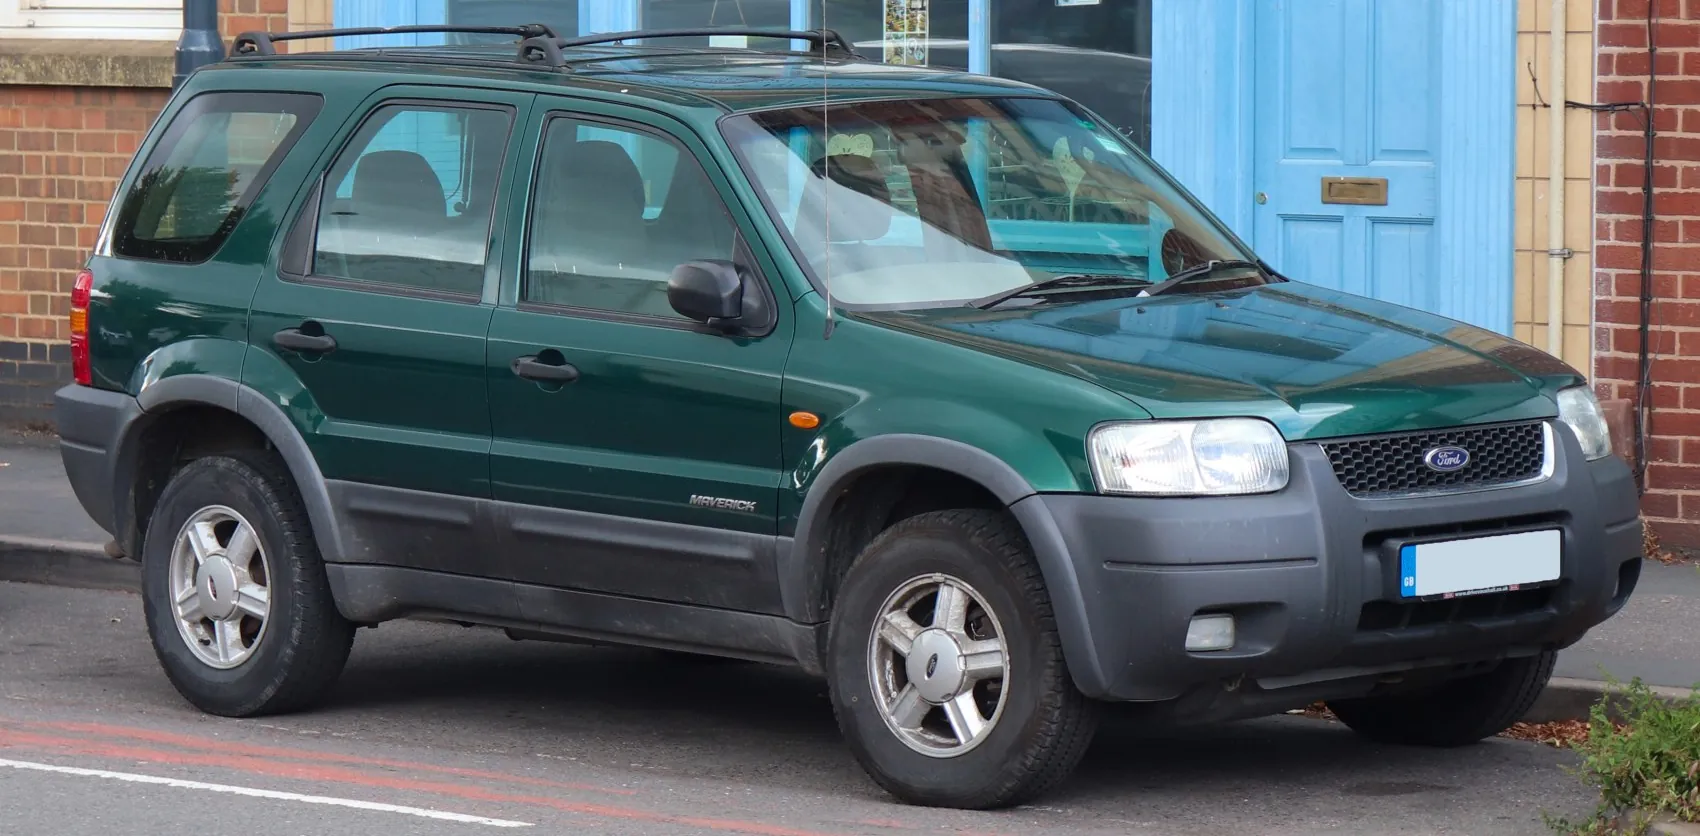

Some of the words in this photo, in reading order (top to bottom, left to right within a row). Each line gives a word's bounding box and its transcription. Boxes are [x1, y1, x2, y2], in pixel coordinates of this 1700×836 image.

[1437, 451, 1461, 466] Ford
[689, 494, 757, 512] MAVERICK
[1404, 576, 1415, 587] GB
